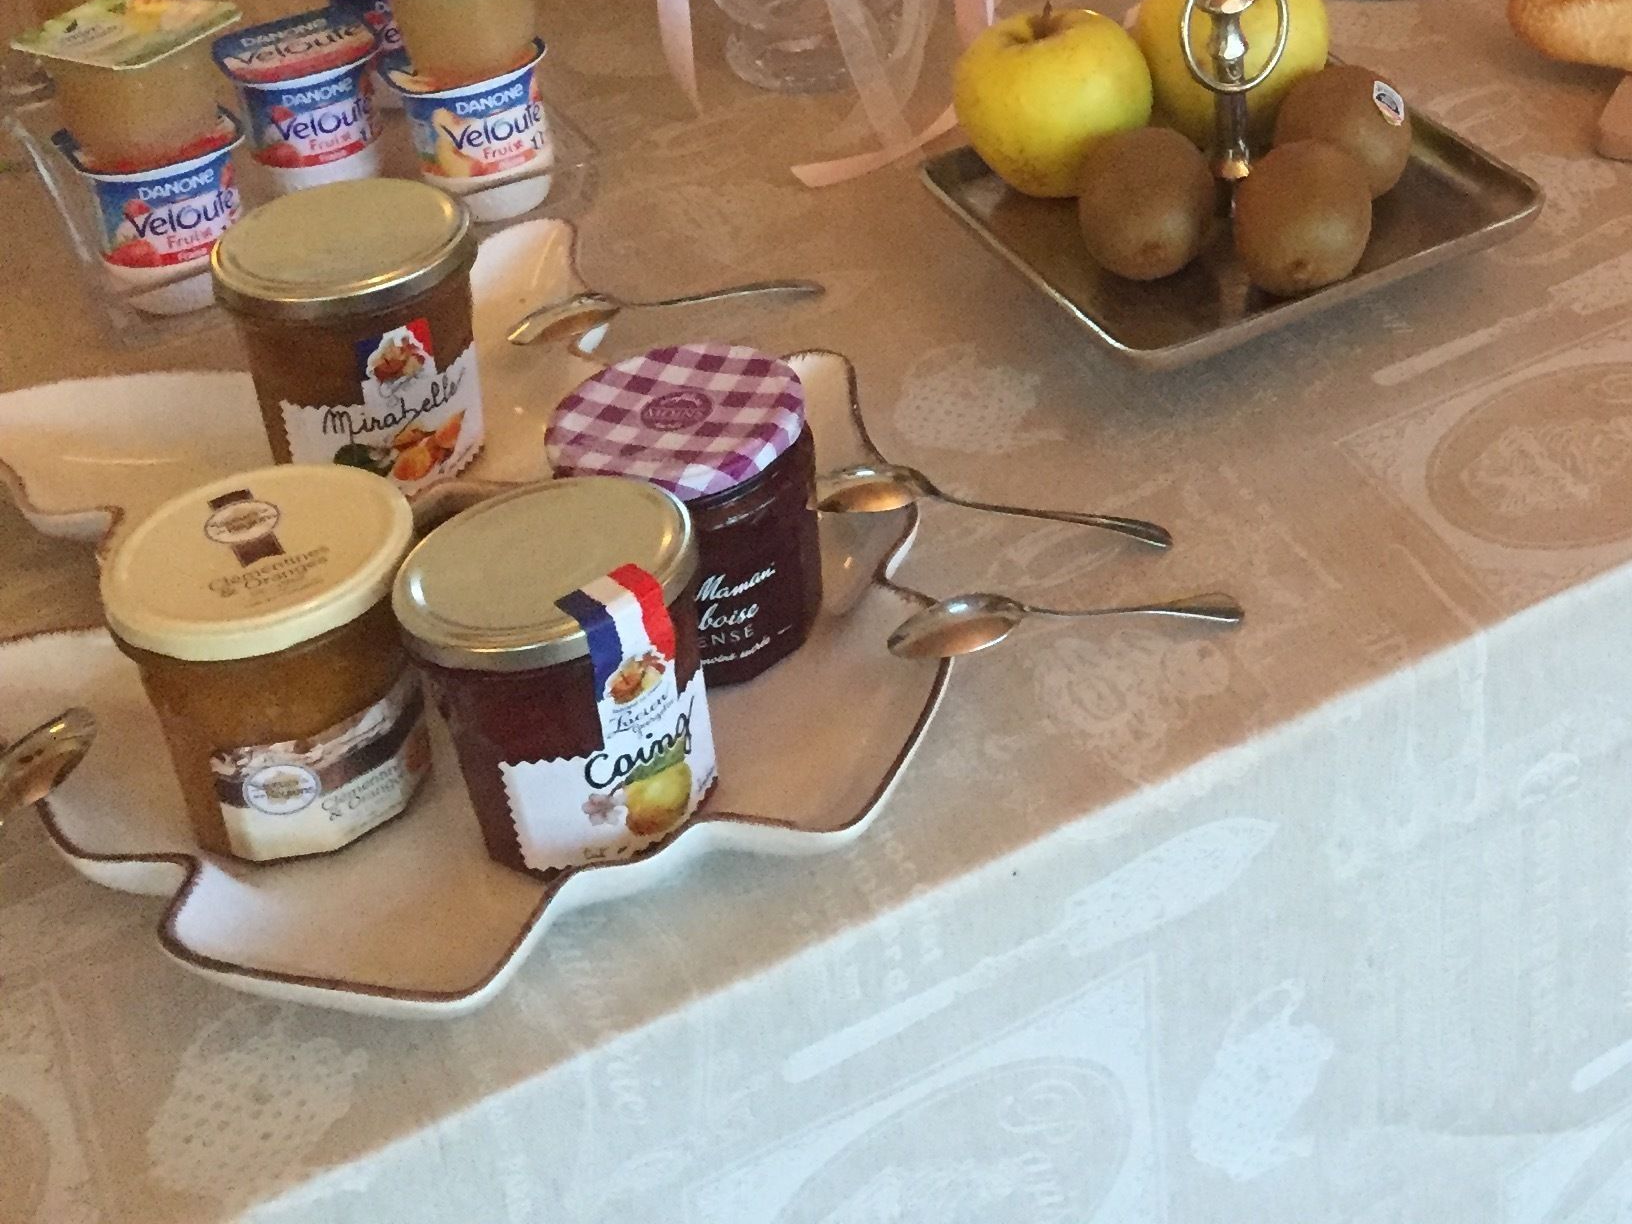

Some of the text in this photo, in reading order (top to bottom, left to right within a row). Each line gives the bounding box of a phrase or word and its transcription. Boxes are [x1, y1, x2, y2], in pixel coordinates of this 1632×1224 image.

[239, 18, 328, 48] DANONE
[281, 77, 353, 108] DANONE
[455, 82, 524, 115] DANONE
[137, 168, 215, 202] DANONE
[322, 367, 466, 445] Mirabelle
[244, 556, 328, 590] Oranges
[694, 566, 777, 603] Maman
[697, 602, 760, 632] boise
[696, 624, 755, 649] ENSE
[584, 694, 695, 790] Coing
